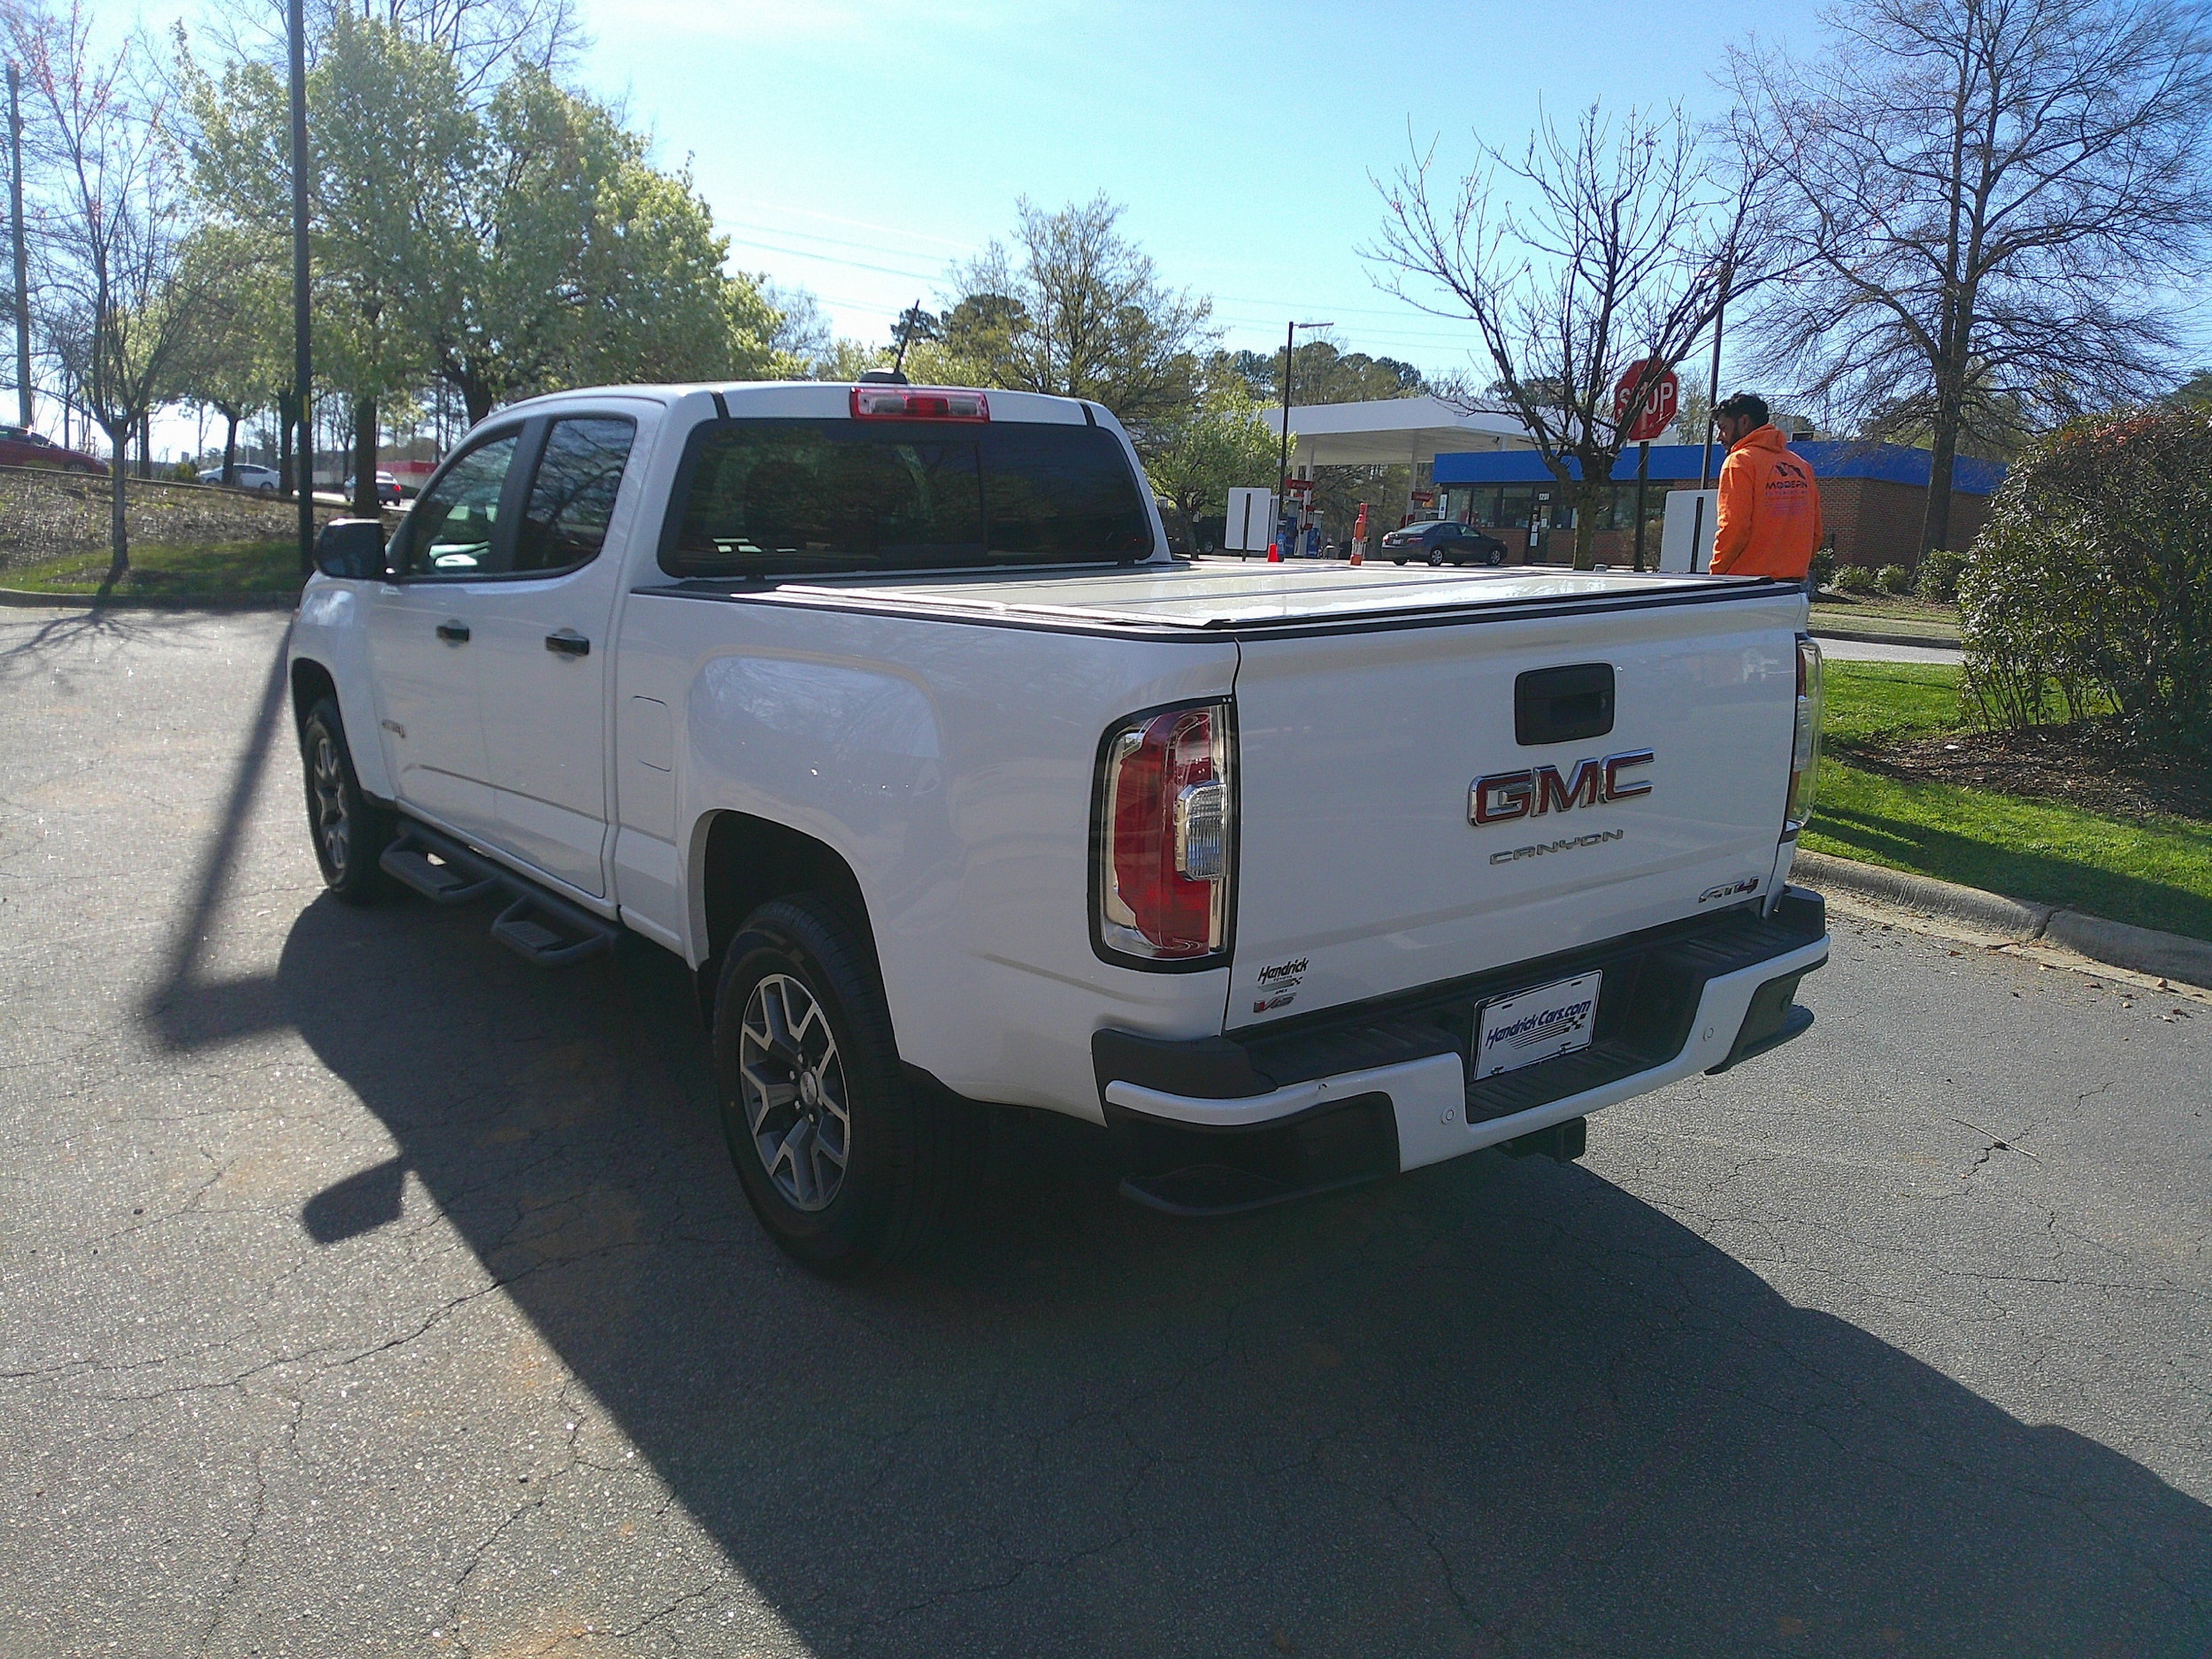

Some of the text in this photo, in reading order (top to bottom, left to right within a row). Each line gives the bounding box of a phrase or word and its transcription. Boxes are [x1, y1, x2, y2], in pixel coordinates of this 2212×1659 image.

[1765, 480, 1808, 489] MODERN
[1468, 748, 1654, 826] GMC
[1490, 829, 1624, 864] CANYON
[1257, 957, 1309, 985] Hendrick
